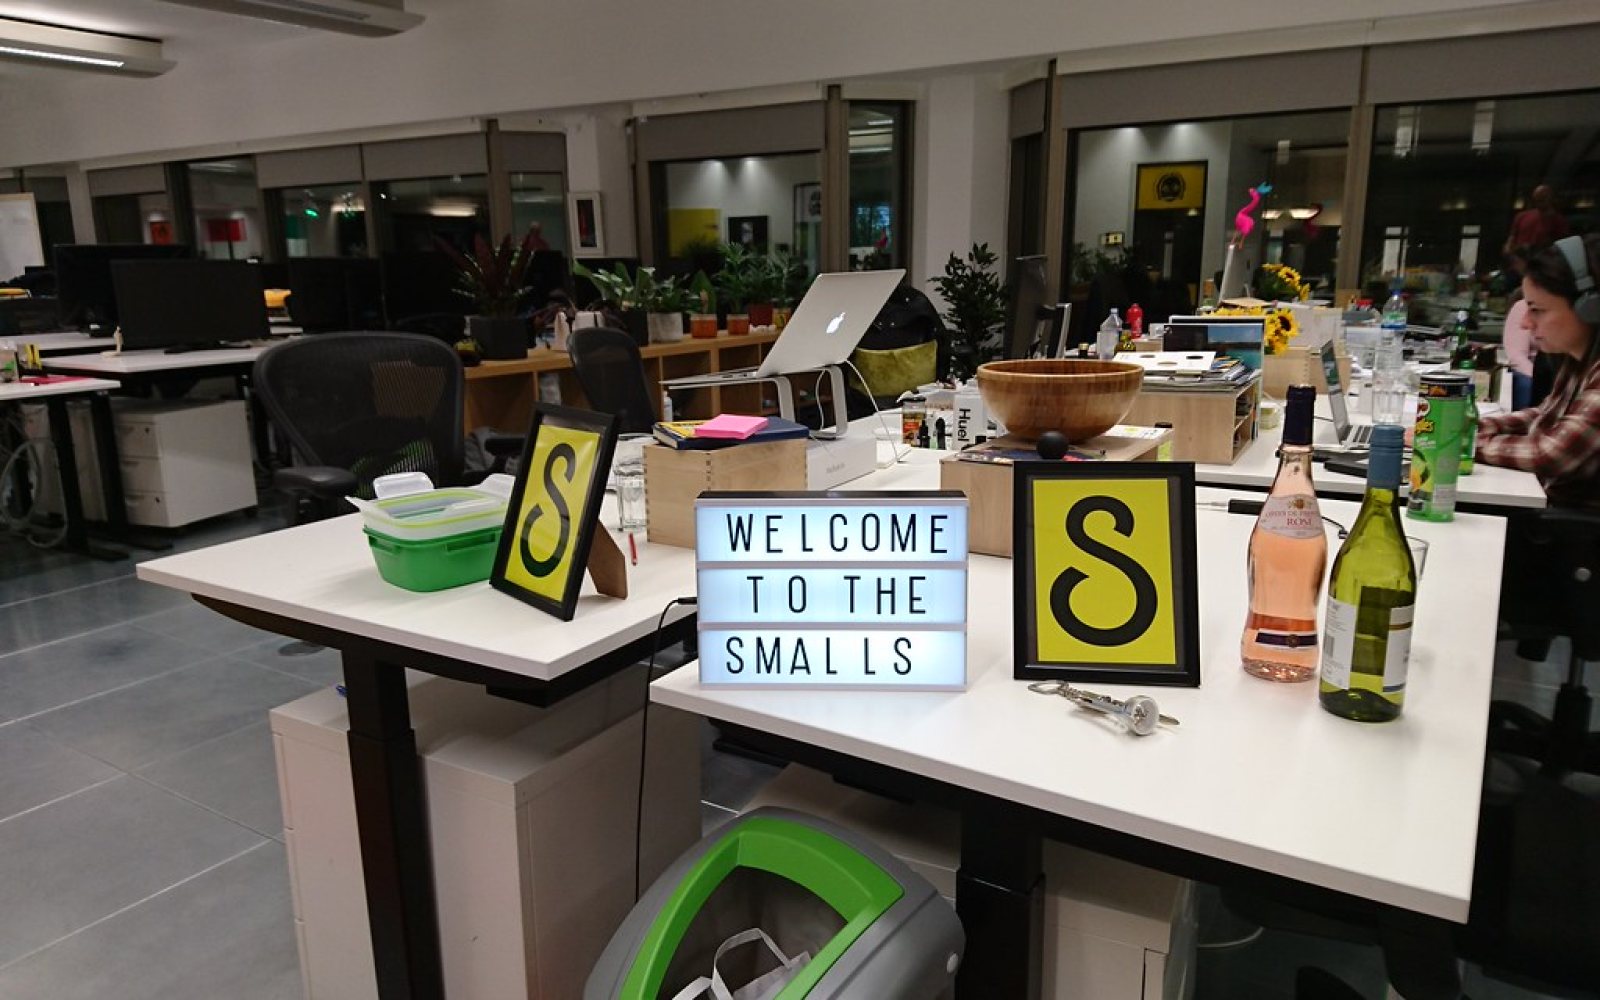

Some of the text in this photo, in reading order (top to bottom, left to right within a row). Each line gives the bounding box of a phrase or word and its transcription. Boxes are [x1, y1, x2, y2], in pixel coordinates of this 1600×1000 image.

[958, 408, 971, 442] Huel
[726, 513, 948, 554] WELCOME
[1050, 495, 1158, 647] S
[746, 575, 927, 615] TO THE
[726, 636, 913, 676] SMALLS
